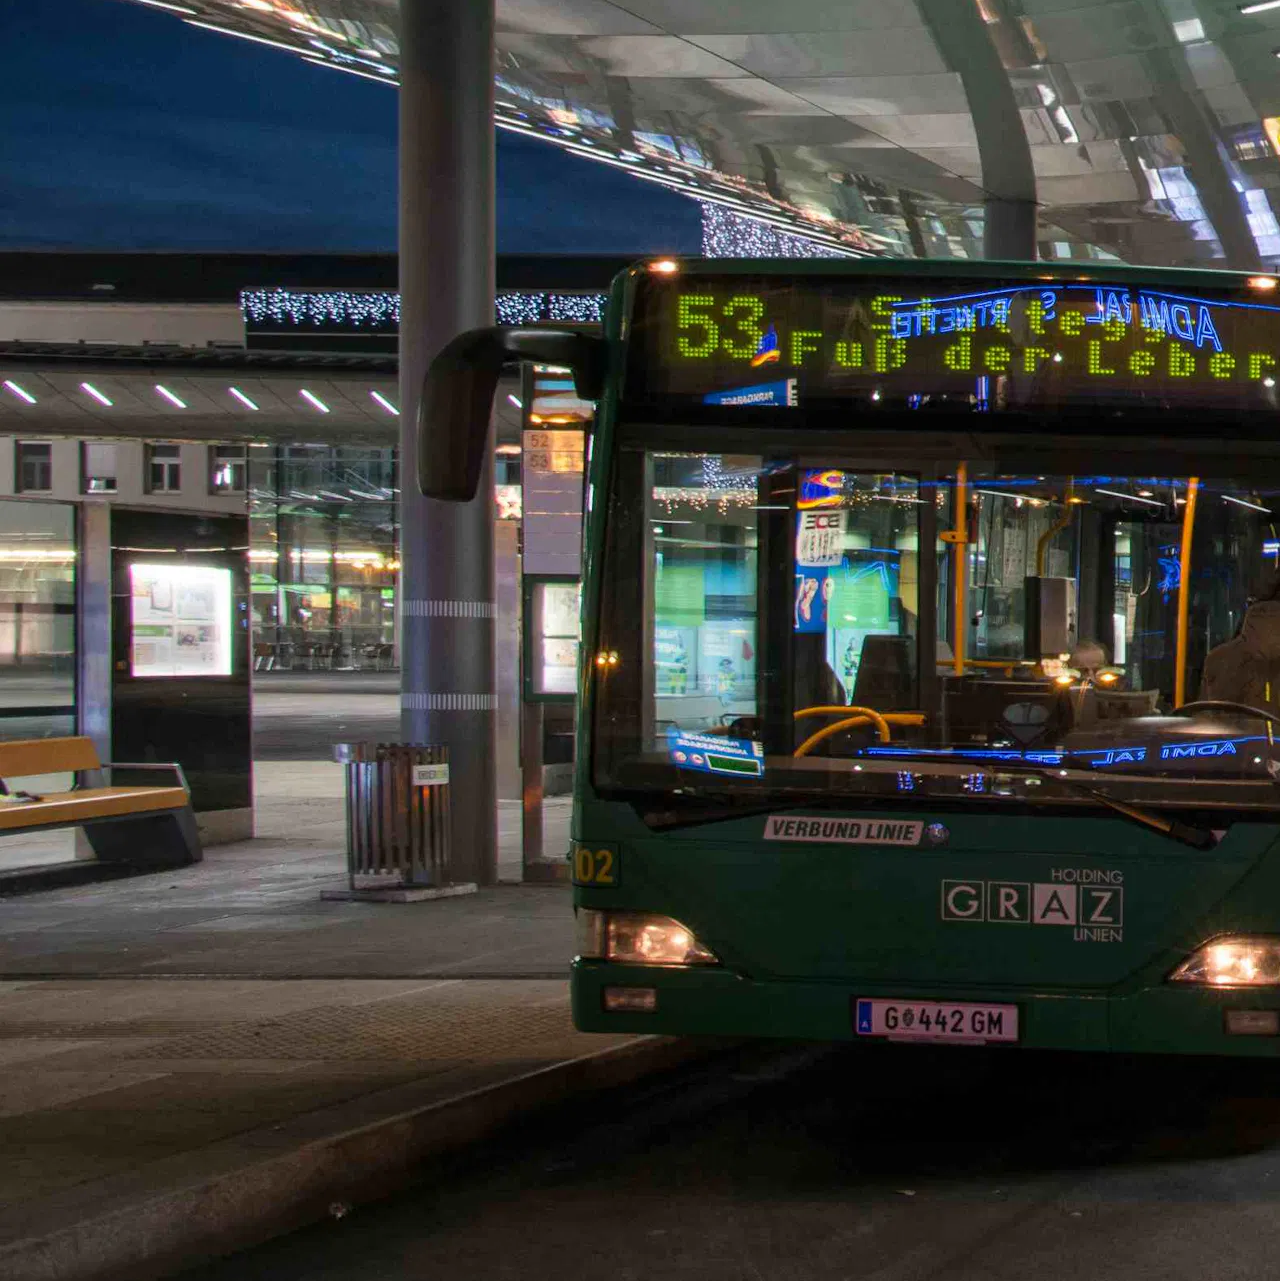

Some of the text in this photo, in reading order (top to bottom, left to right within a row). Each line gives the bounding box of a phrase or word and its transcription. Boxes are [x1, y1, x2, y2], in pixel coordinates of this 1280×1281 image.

[678, 295, 763, 358] 53
[944, 336, 1050, 372] der
[1088, 339, 1276, 379] Leber
[772, 818, 915, 841] VERBUND LINIE
[1051, 868, 1124, 884] HOLDING
[945, 883, 1116, 924] GRAZ
[1073, 928, 1124, 943] LINIEN
[884, 1006, 1003, 1035] G 442 GM
